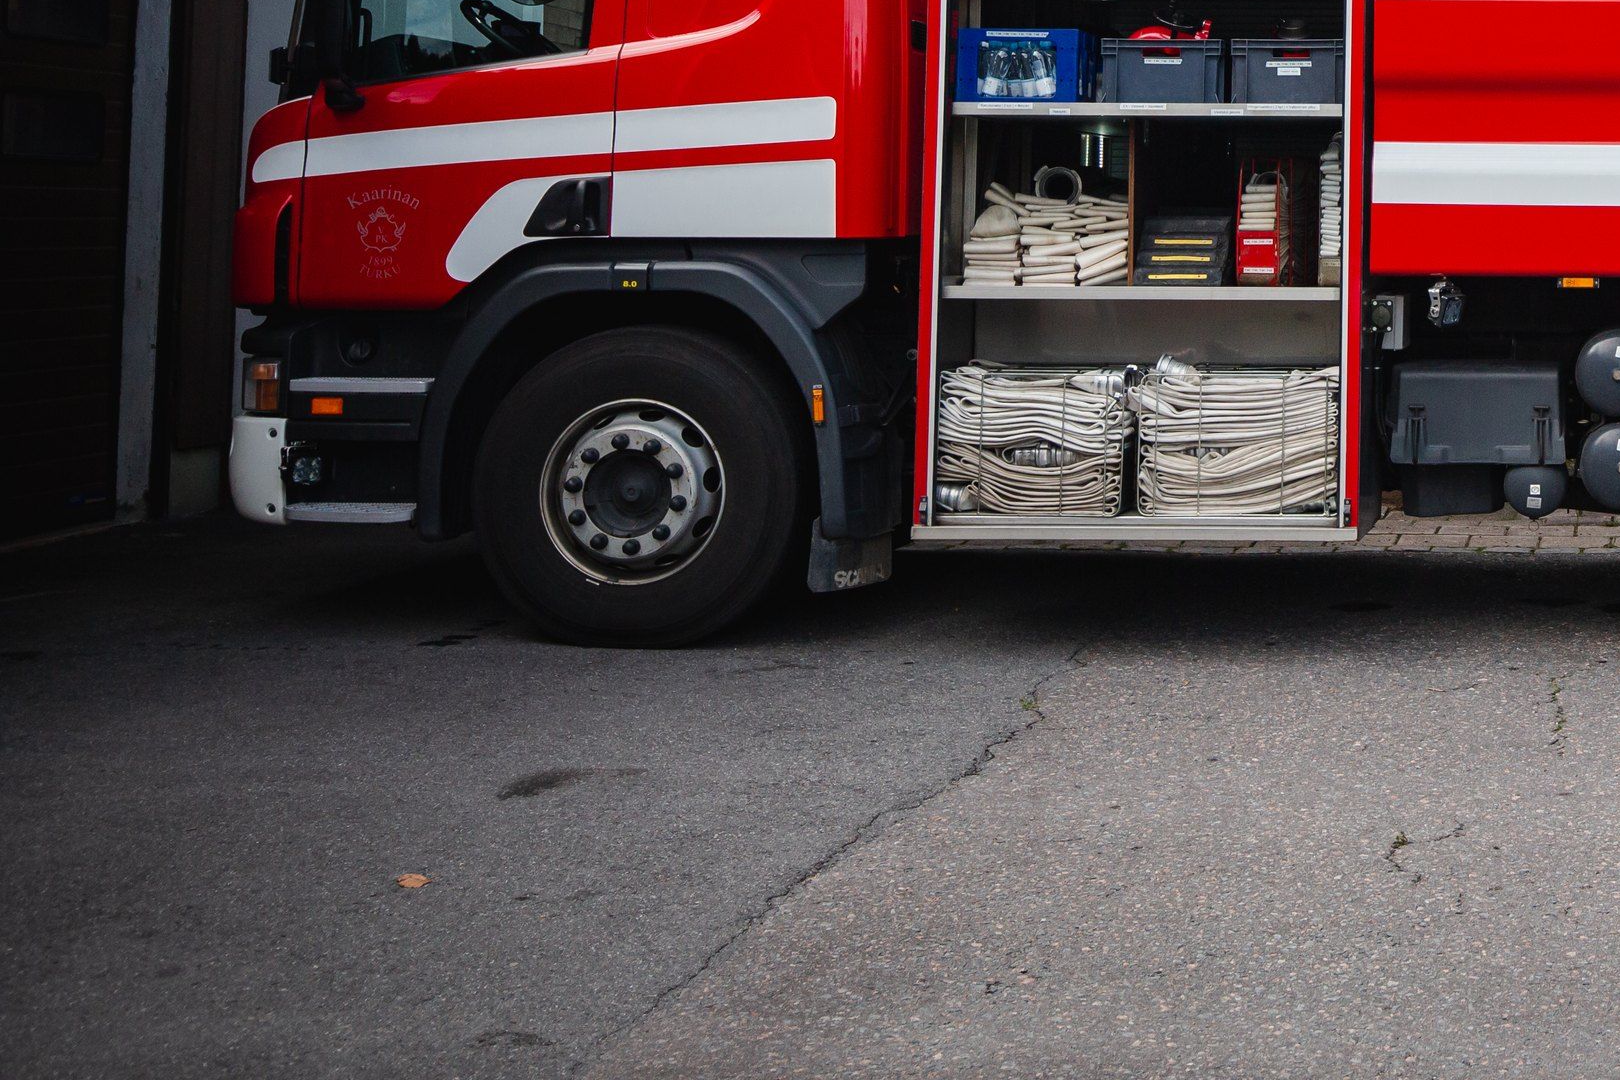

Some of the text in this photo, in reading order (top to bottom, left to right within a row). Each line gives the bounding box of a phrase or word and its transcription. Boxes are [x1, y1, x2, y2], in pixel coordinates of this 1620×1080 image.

[346, 184, 421, 210] Kaarinan
[368, 255, 393, 266] 1899
[359, 263, 401, 279] TURKU
[622, 280, 637, 288] 8.0
